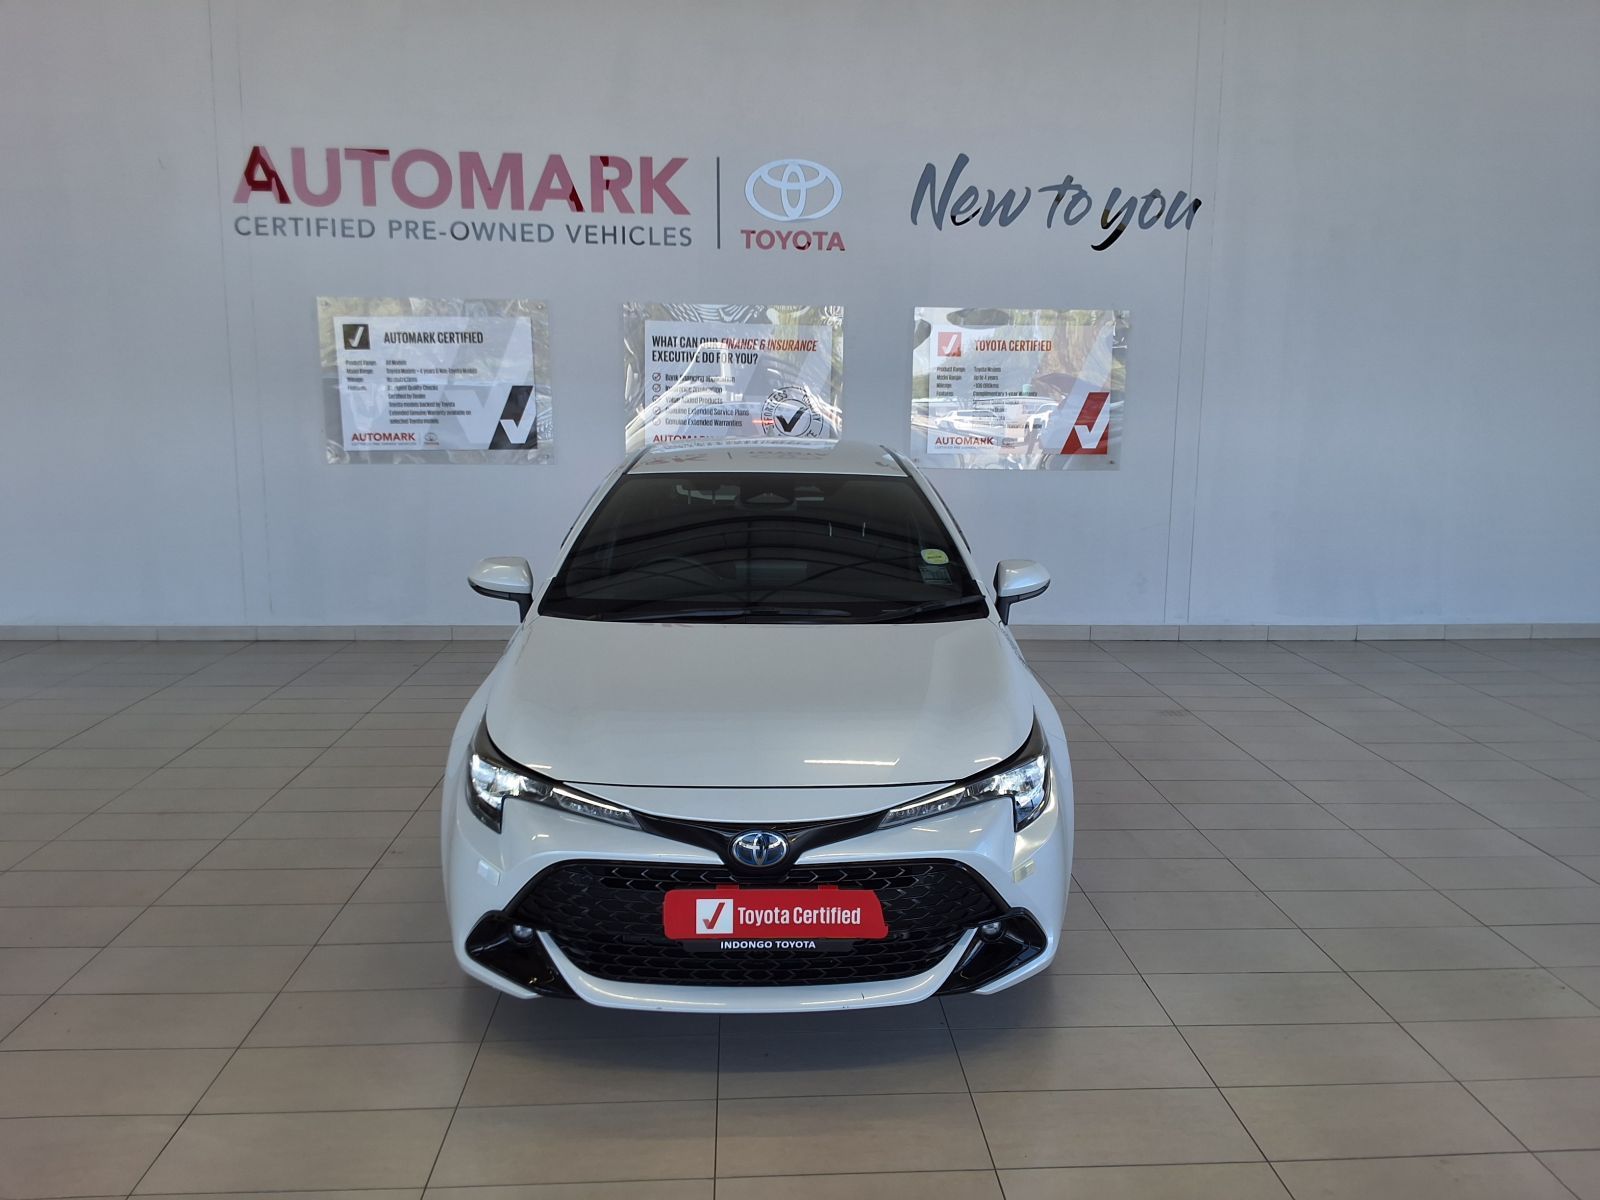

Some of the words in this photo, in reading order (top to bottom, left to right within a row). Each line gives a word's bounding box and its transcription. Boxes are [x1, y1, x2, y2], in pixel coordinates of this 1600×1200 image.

[233, 145, 691, 215] AUTOMARK
[910, 153, 1032, 231] New
[1037, 174, 1093, 229] to
[1090, 186, 1203, 252] you
[234, 215, 376, 240] CERTIFIED
[389, 219, 555, 244] PRE-OWNED
[565, 223, 693, 247] VEHICLES
[740, 229, 846, 252] TOYOTA
[383, 331, 435, 344] AUTOMARK
[437, 331, 484, 344] CERTIFIED
[651, 335, 678, 348] WHAT
[679, 336, 698, 348] CAN
[720, 338, 759, 350] FINANCE
[766, 339, 819, 352] INSURANCE
[974, 339, 1008, 352] TOYOTA
[1008, 339, 1052, 352] CERTIFIED
[651, 351, 701, 363] EXECUTIVE
[702, 352, 714, 364] DO
[716, 352, 733, 364] FOR
[734, 353, 759, 365] YOU?
[665, 373, 679, 382] Bank
[713, 408, 733, 416] Service
[351, 432, 416, 442] AUTOMARK
[935, 436, 994, 446] AUTOMARK
[737, 906, 790, 927] Toyota
[793, 906, 861, 925] Certified
[720, 941, 773, 950] INDONGO
[774, 941, 816, 949] TOYOTA
